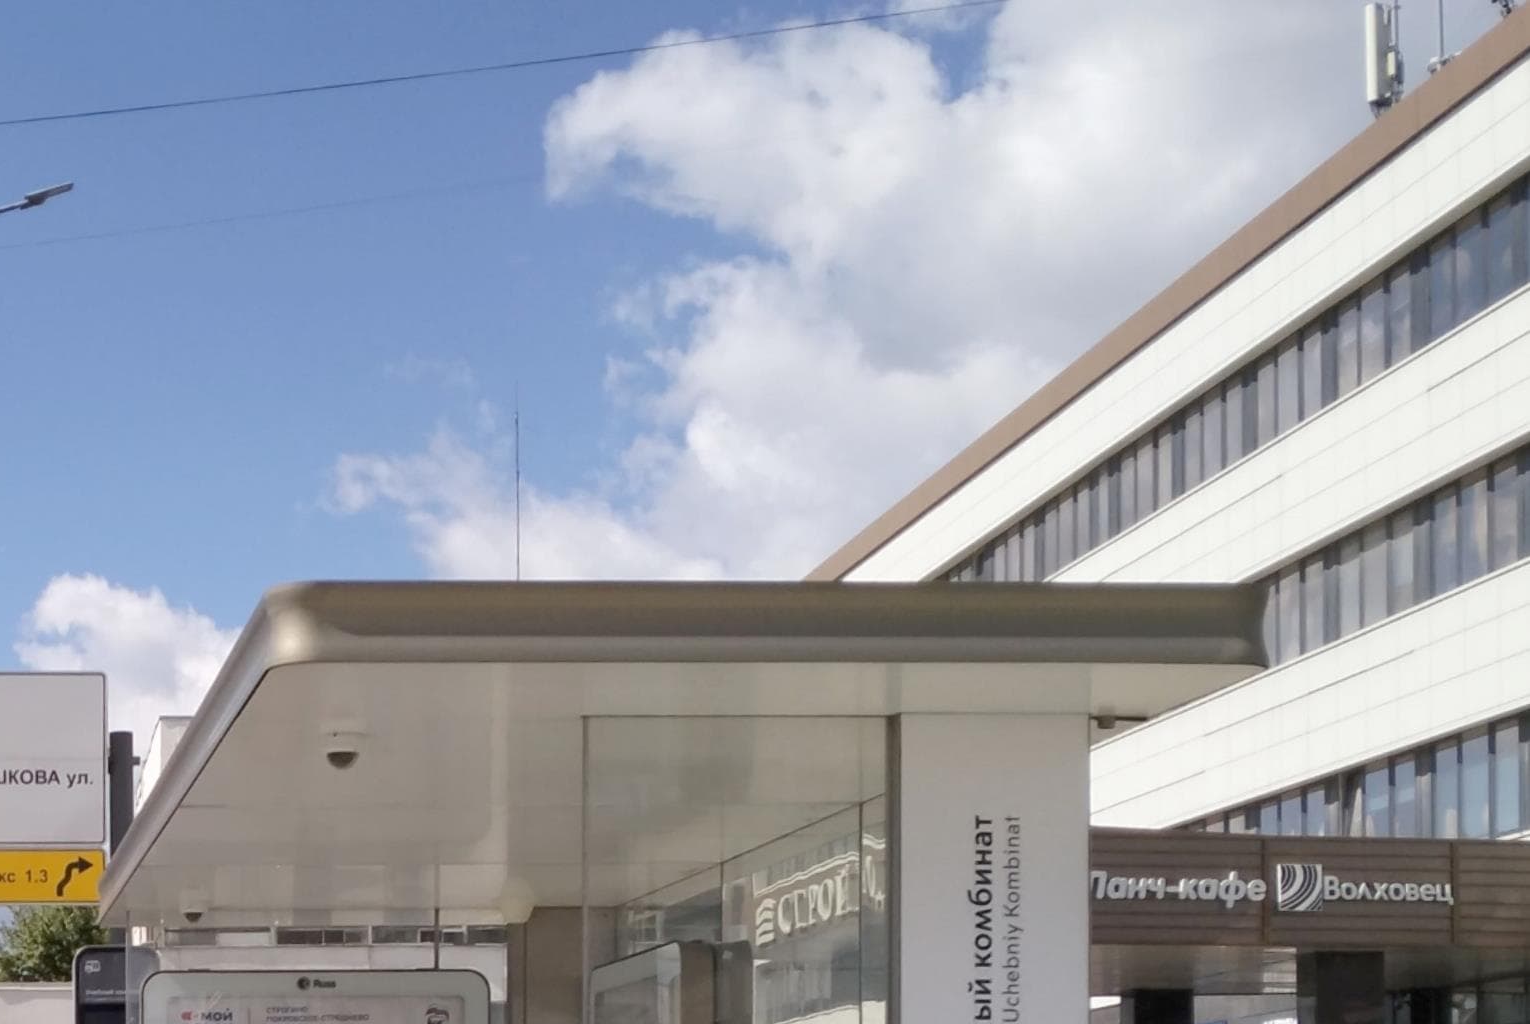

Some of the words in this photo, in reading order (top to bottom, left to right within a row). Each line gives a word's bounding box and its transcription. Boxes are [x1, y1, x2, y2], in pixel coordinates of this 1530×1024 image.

[66, 773, 94, 790] ул.
[25, 868, 49, 884] 1.3
[967, 815, 993, 967] комбинат
[1003, 815, 1021, 917] Kombinat
[1323, 876, 1455, 906] Волховец
[1003, 925, 1024, 1023] Uchebniy
